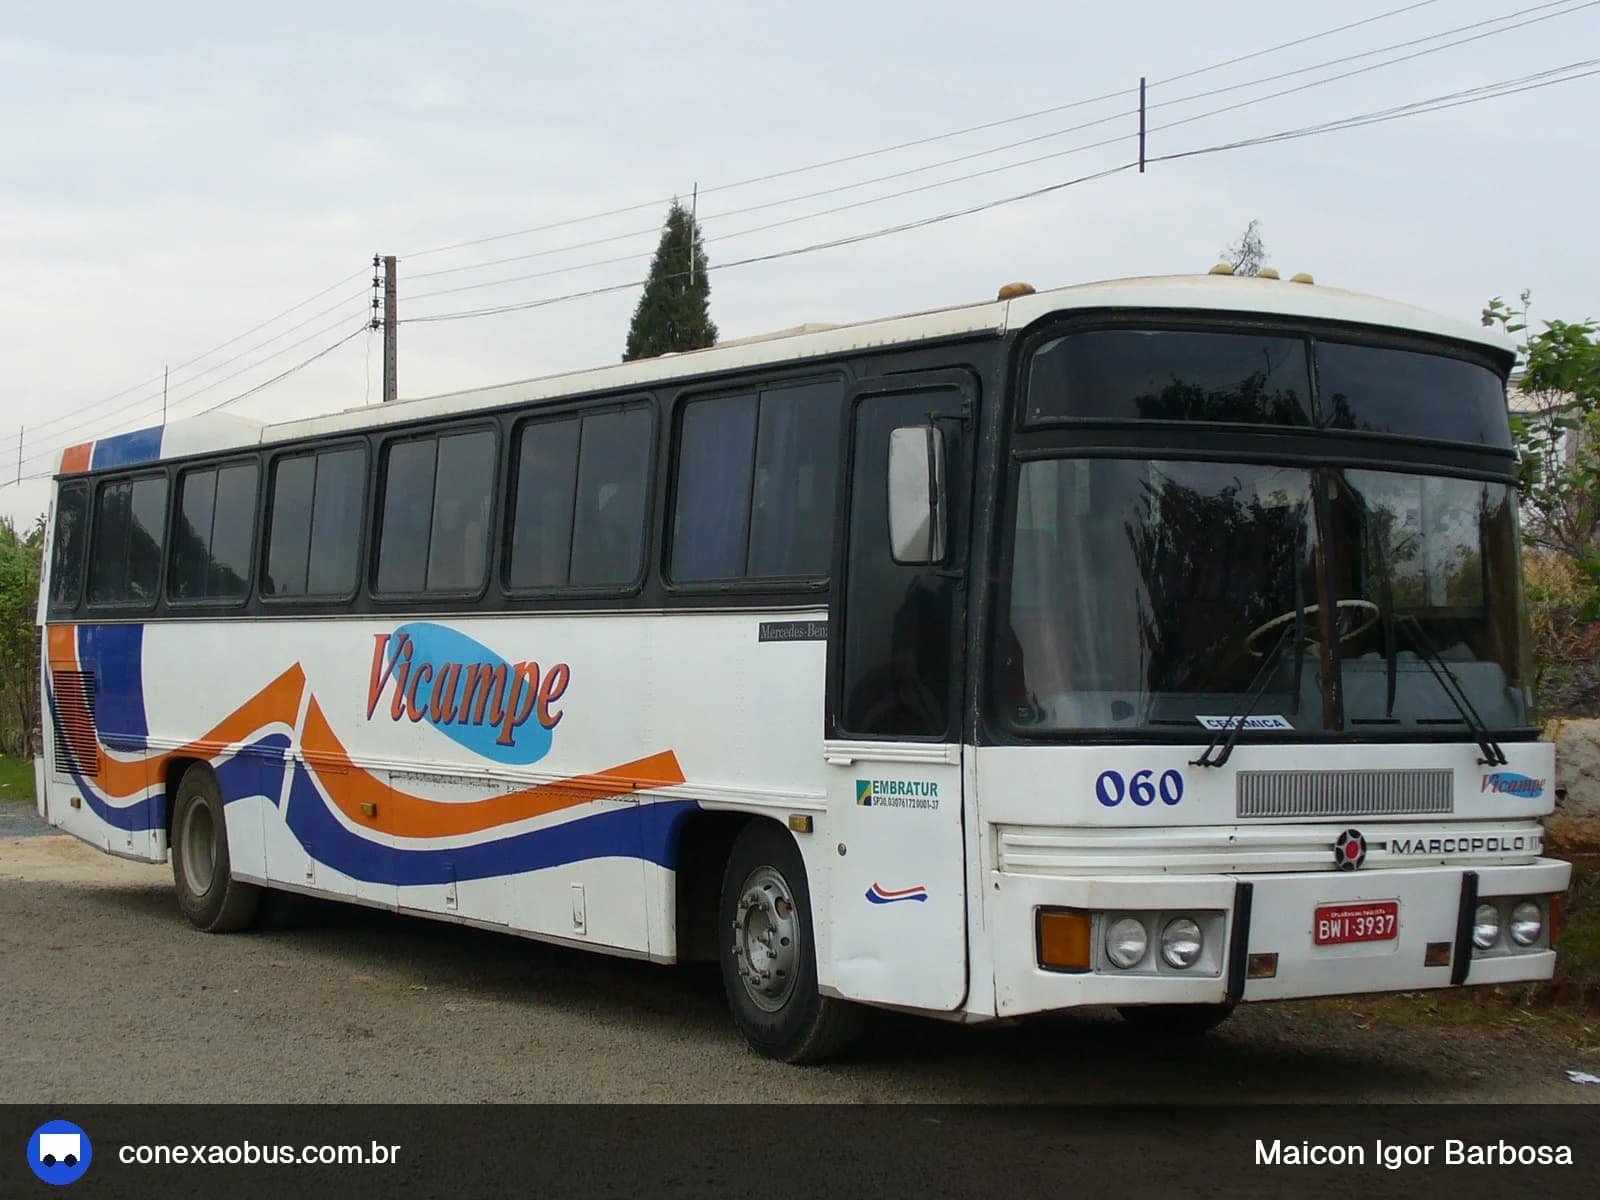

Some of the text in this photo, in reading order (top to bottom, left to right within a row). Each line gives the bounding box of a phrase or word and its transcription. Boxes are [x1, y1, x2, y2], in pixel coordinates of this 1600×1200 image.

[367, 633, 570, 747] Vicampe
[872, 780, 938, 797] EMBRATUR
[1095, 769, 1184, 807] 060
[1480, 774, 1546, 798] Vicampe
[1392, 836, 1525, 854] MARCOPOLO
